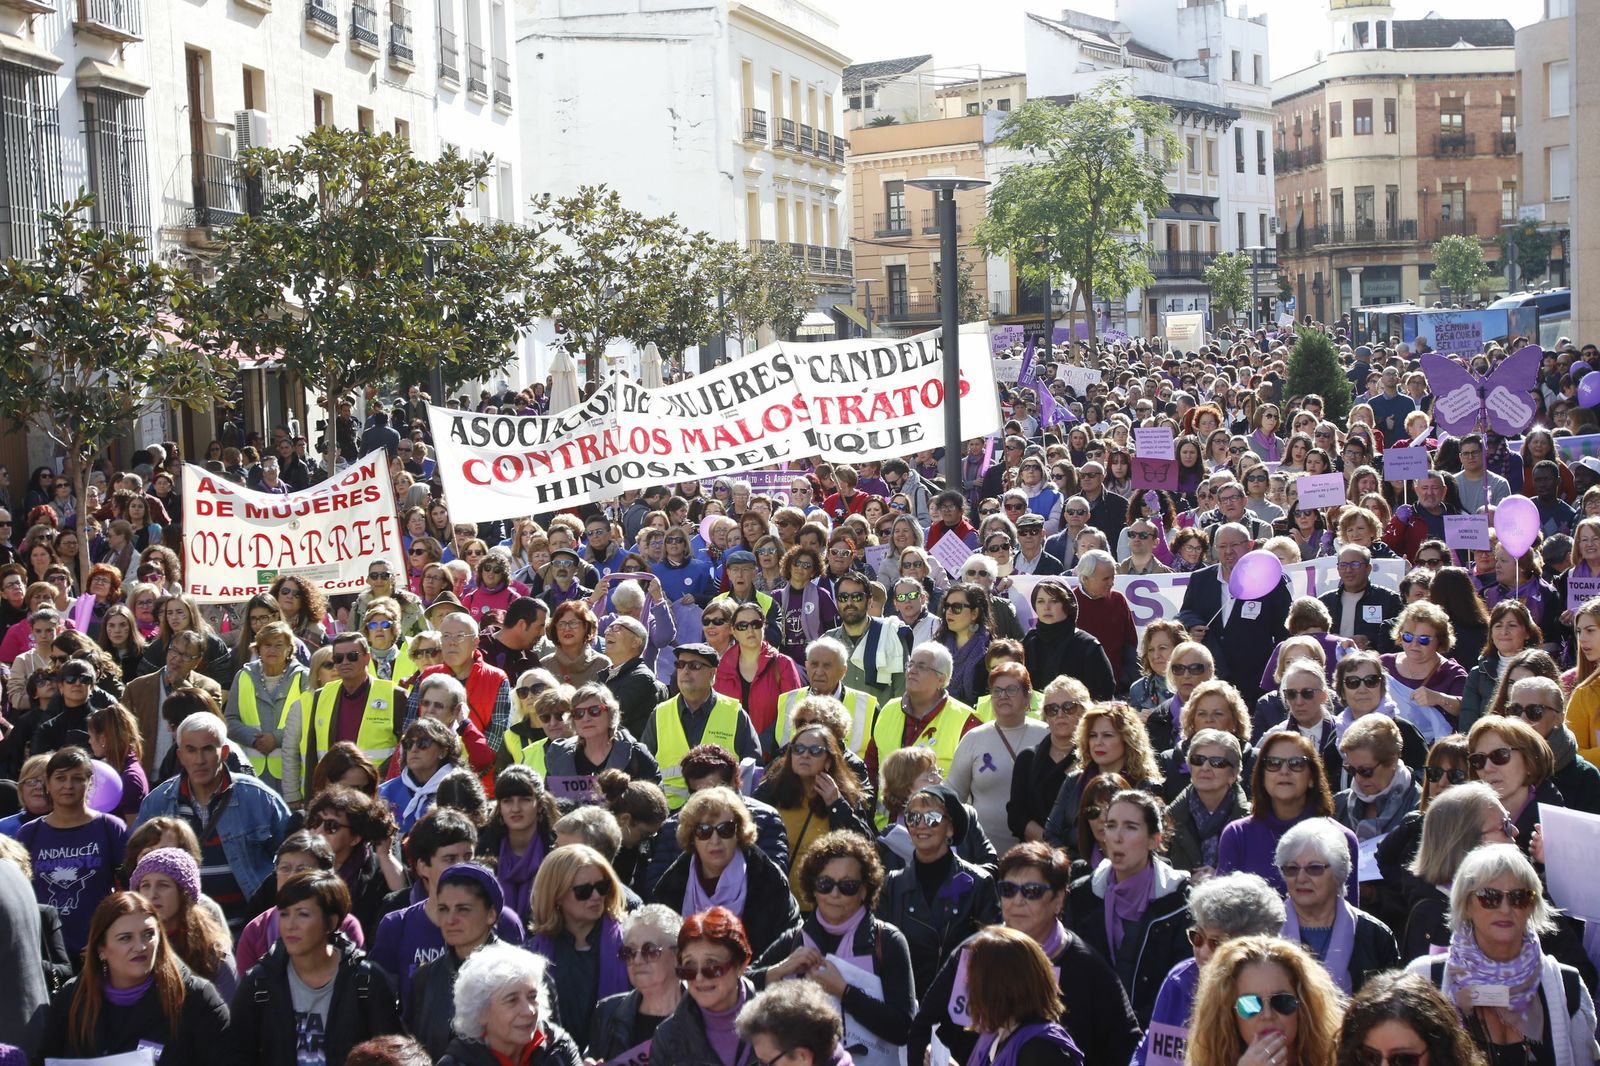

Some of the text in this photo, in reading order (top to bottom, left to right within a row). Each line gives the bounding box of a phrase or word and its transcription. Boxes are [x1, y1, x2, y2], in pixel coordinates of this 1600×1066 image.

[623, 384, 651, 414] DE
[462, 427, 619, 485] CONTRA
[616, 425, 673, 455] LOS
[680, 392, 812, 454] MALOS
[704, 444, 790, 472] DEL
[764, 474, 772, 483] EL
[196, 485, 381, 519] DE MUJERES
[190, 516, 392, 569] MUDARREF
[191, 585, 212, 596] EL
[1569, 582, 1594, 590] TOCAN
[38, 842, 100, 860] ANDALUCÍA
